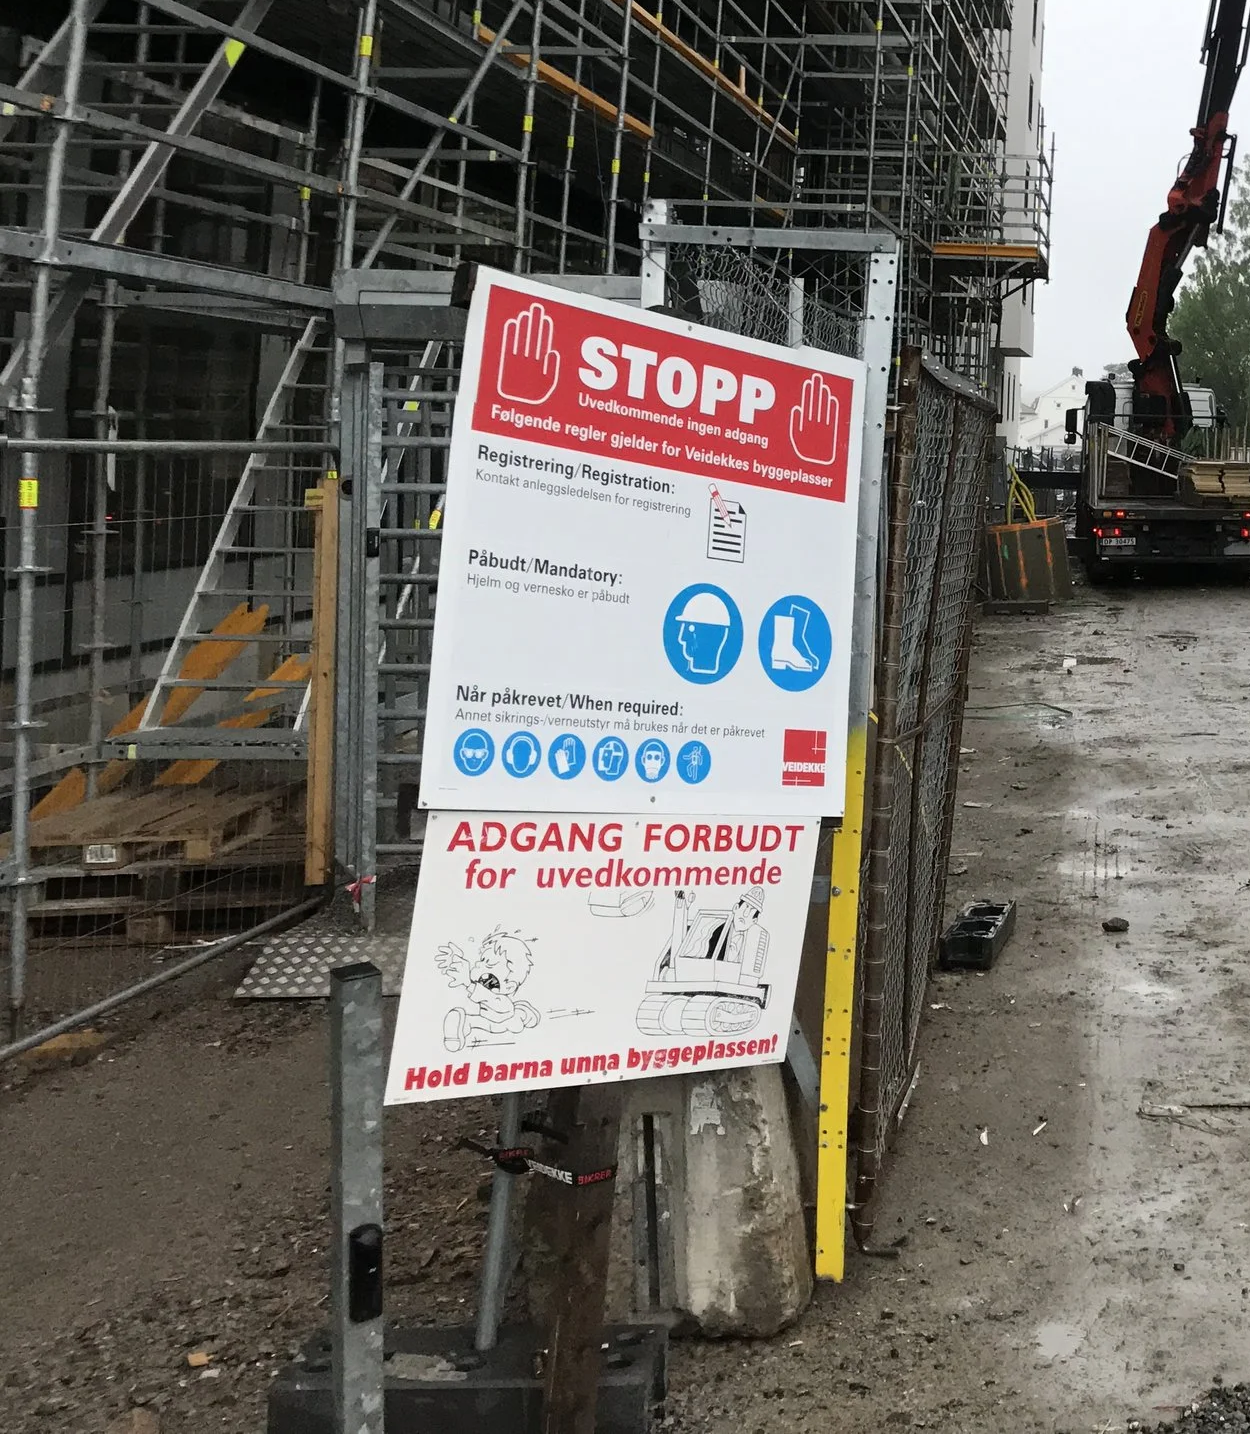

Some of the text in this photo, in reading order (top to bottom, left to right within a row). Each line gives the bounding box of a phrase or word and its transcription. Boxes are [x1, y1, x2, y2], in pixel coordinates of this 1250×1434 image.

[579, 336, 776, 424] STOPP
[579, 392, 769, 449] Uvedkommende ingen adgang
[491, 404, 833, 488] Følgende regler gjelder for Veidekkes byggeplasser
[478, 444, 675, 495] Registrering/Registration:
[475, 468, 691, 518] Kontakt anleggsledelsen for registrering
[468, 549, 623, 587] Påbudt/Mandatory:
[467, 572, 630, 605] Hjelm og vernesko er påbudt
[456, 684, 684, 717] Når påkrevet/When required:
[455, 708, 765, 738] Annet sikrings-/verneutstyr må brukes når det er påkrevet
[783, 761, 826, 774] VEIDEKKE
[447, 821, 805, 853] ADGANG FORBUDT
[465, 858, 782, 889] for uvedkommende
[404, 1033, 779, 1091] Hold barna unna byggeplassen!
